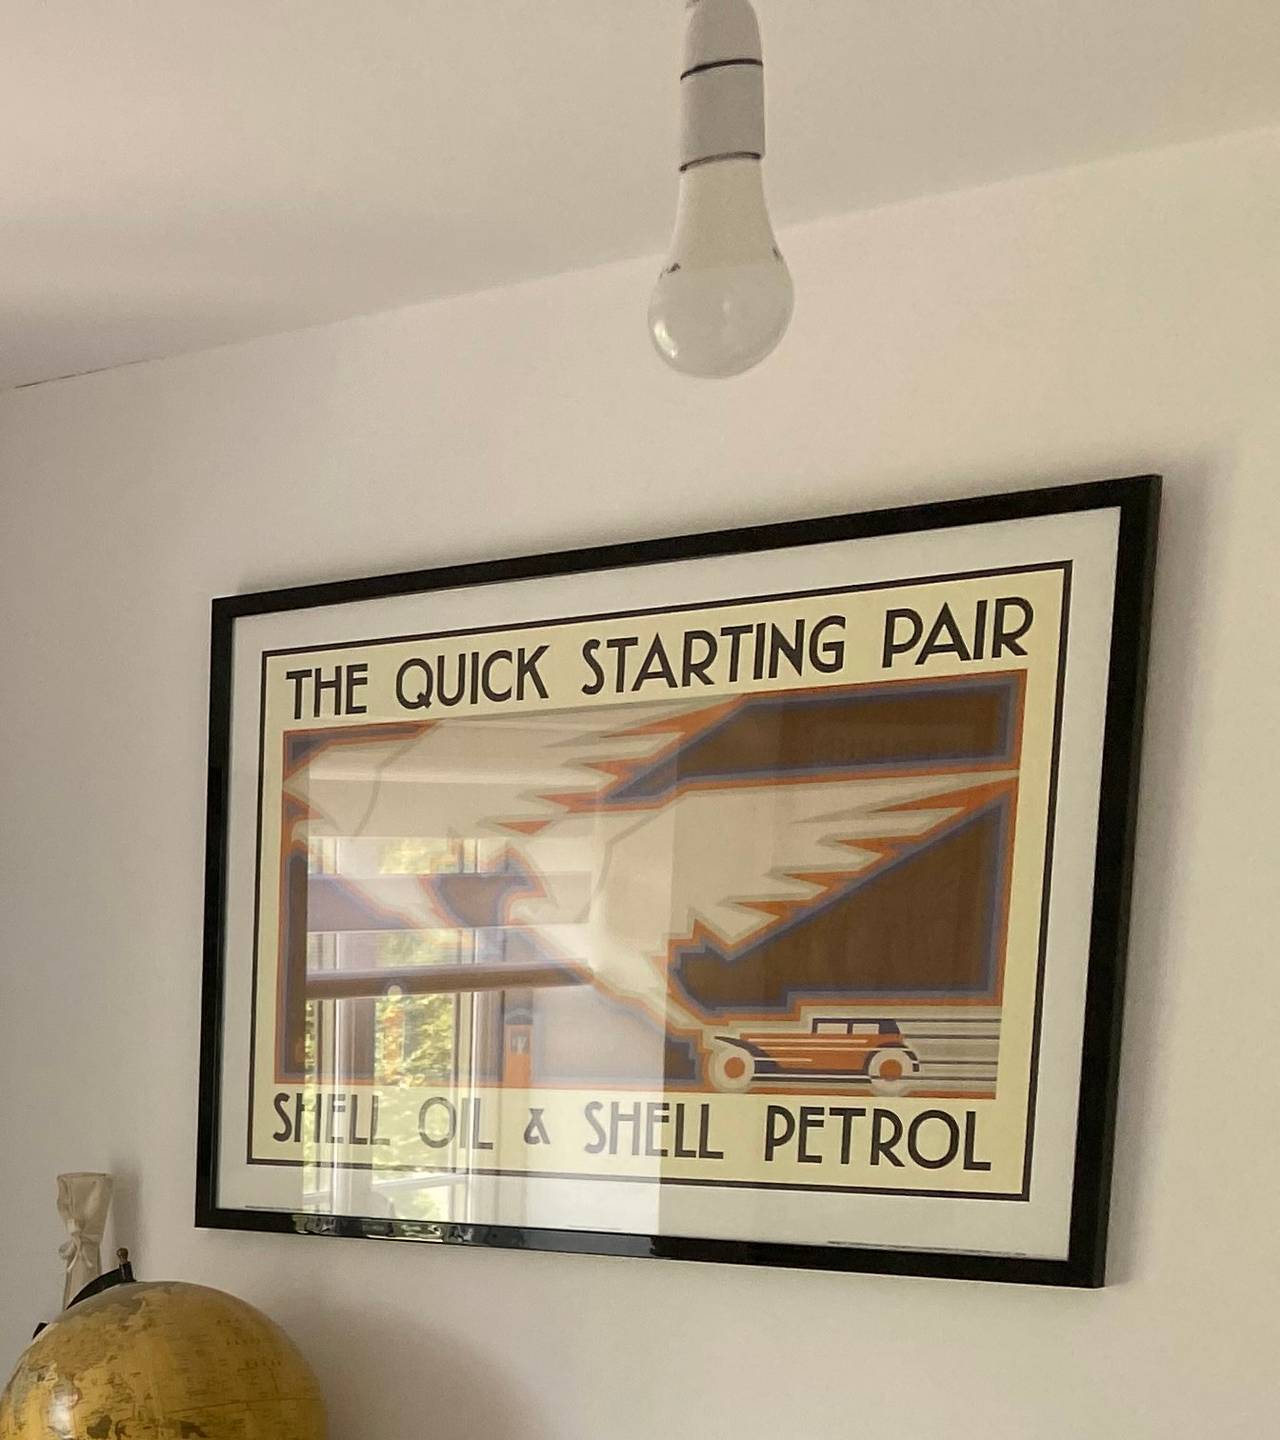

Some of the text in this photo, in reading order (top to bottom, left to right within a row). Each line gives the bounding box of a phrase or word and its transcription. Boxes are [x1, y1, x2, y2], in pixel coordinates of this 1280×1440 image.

[285, 596, 1034, 720] THE QUICK STARTING PAIR
[272, 1092, 390, 1145] SHELL
[418, 1096, 493, 1150] OIL
[584, 1100, 724, 1160] SHELL
[765, 1104, 991, 1171] PETROL
